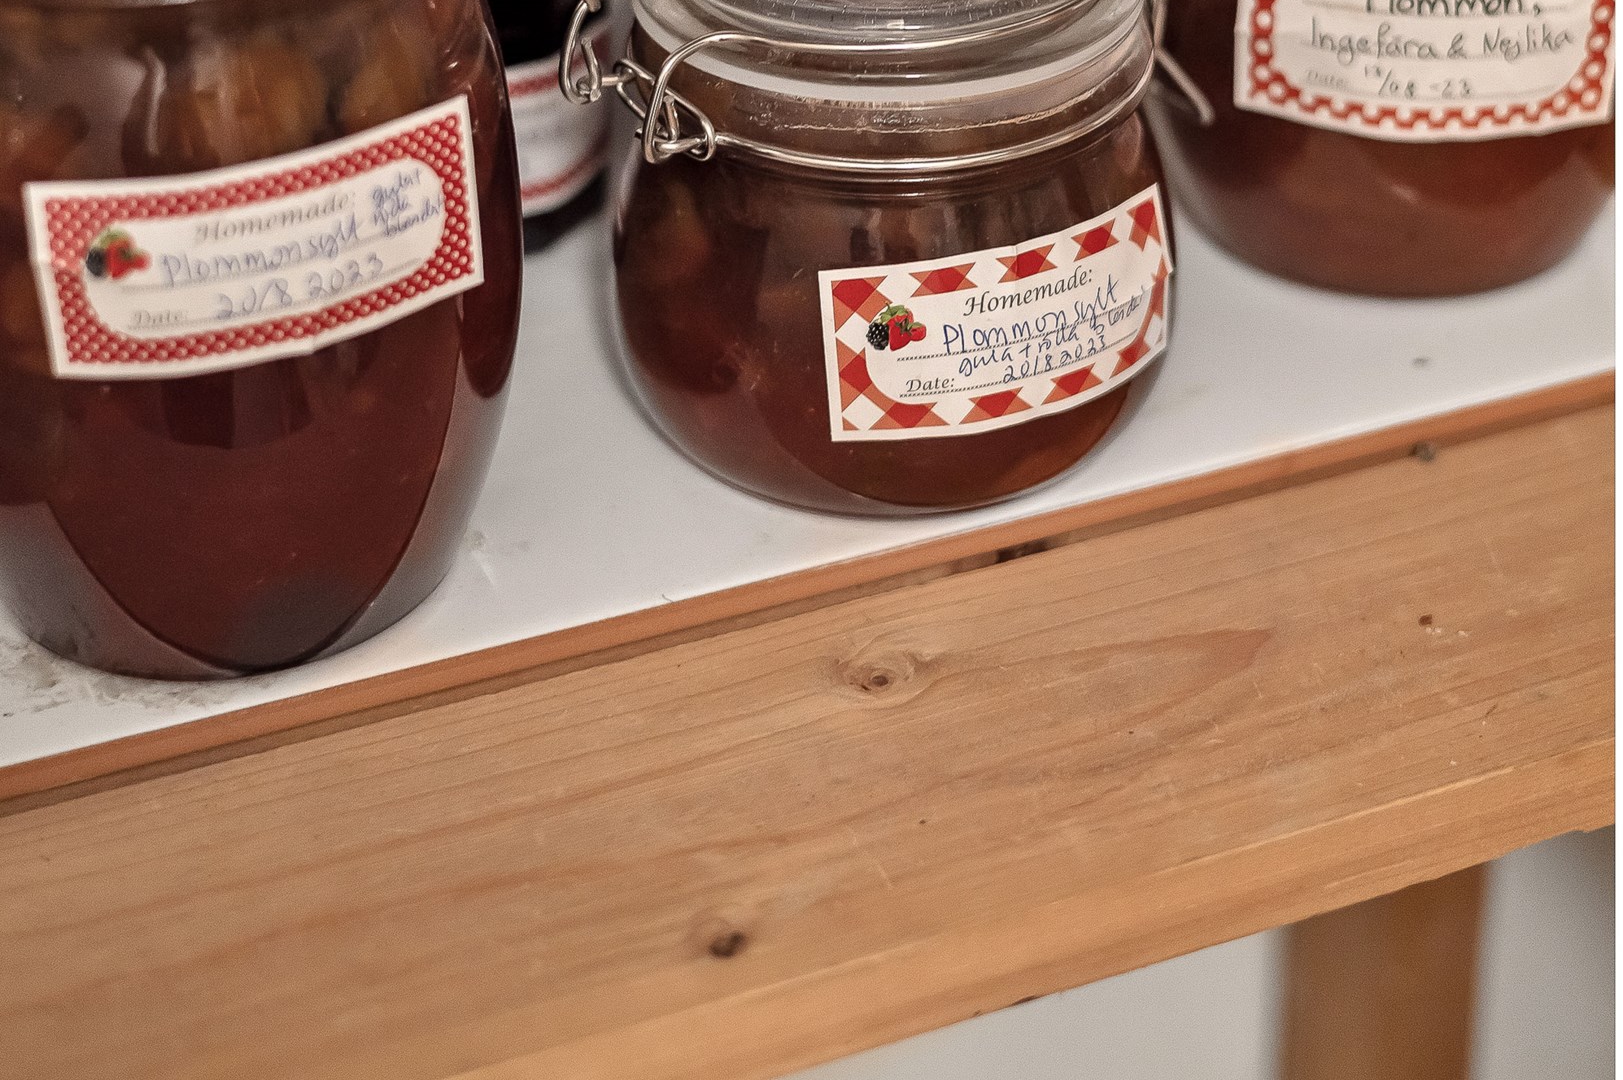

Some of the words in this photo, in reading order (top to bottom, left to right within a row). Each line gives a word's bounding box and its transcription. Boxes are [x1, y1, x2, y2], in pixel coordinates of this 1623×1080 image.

[195, 193, 355, 244] Homemade:
[963, 267, 1093, 317] Homemade:
[1059, 335, 1108, 364] 2023
[906, 377, 956, 393] Date:
